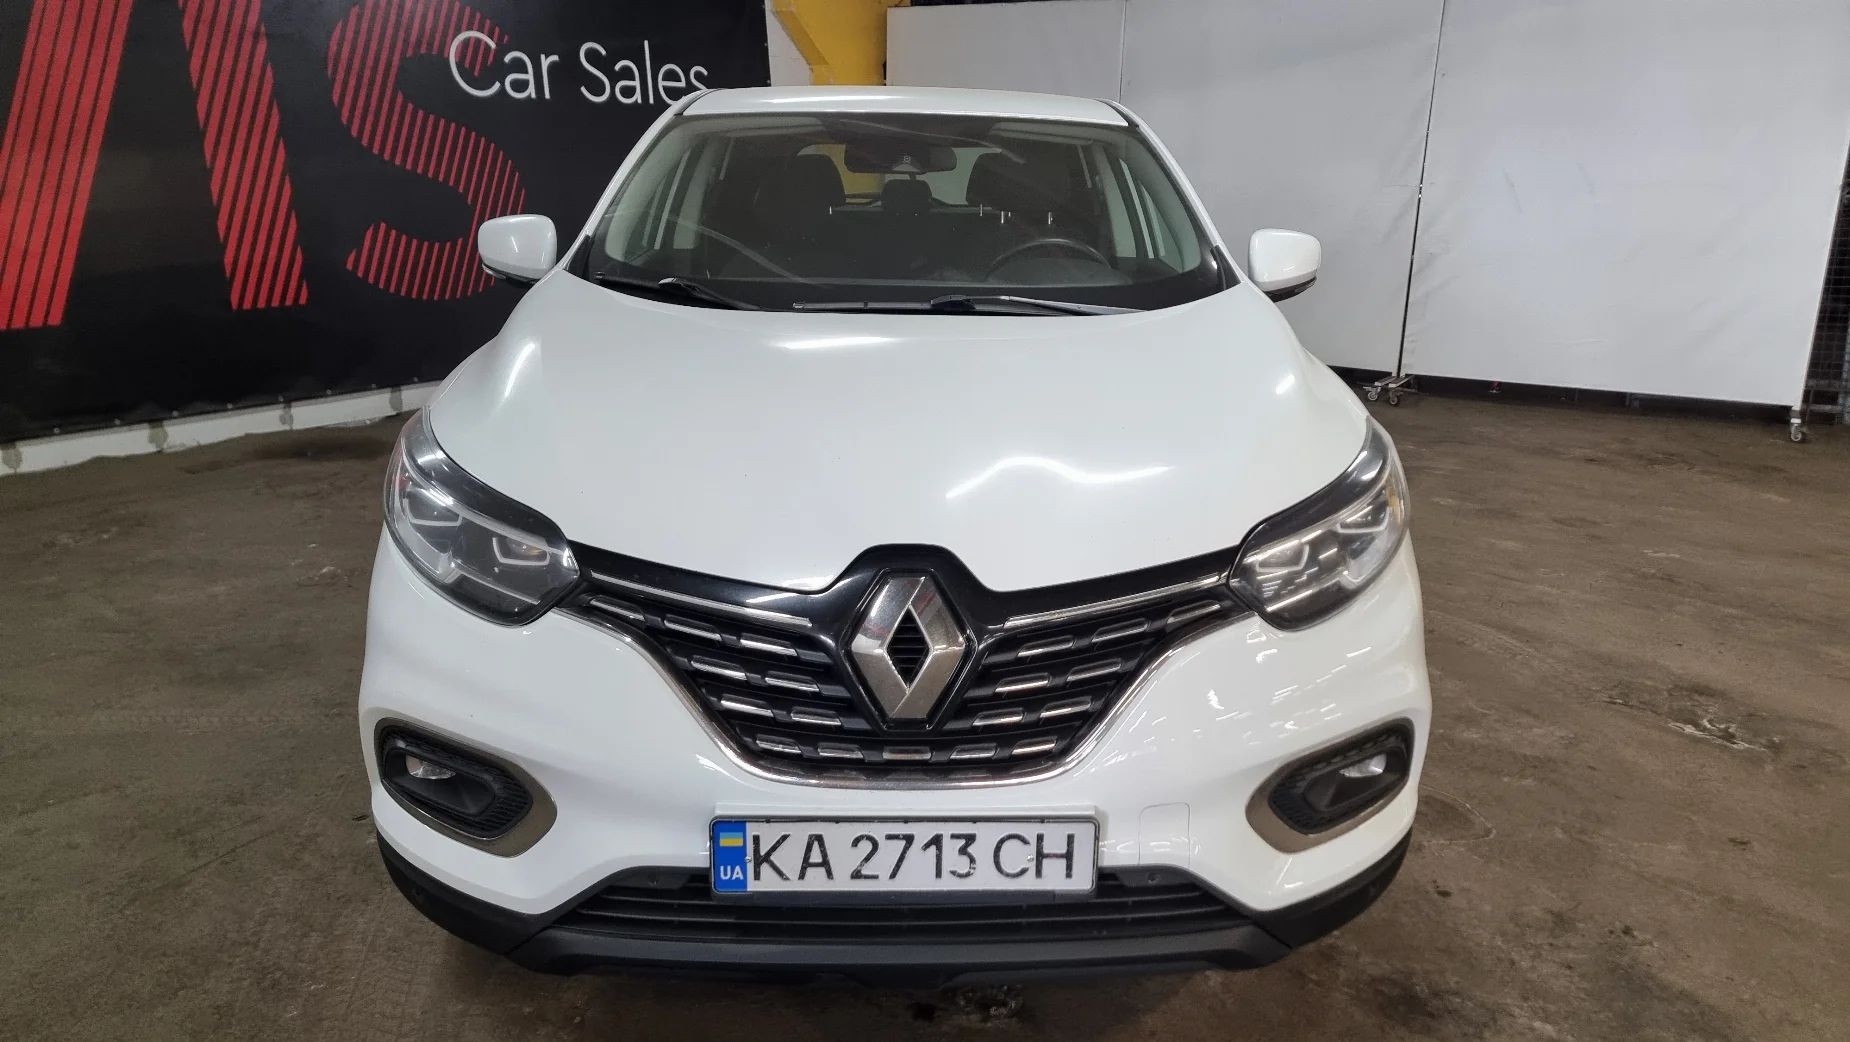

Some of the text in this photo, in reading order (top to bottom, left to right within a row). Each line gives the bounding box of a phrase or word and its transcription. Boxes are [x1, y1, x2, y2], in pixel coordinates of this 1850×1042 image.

[449, 30, 709, 104] Car Sales
[720, 865, 744, 881] UA
[752, 832, 1076, 881] KA 2713 CH
